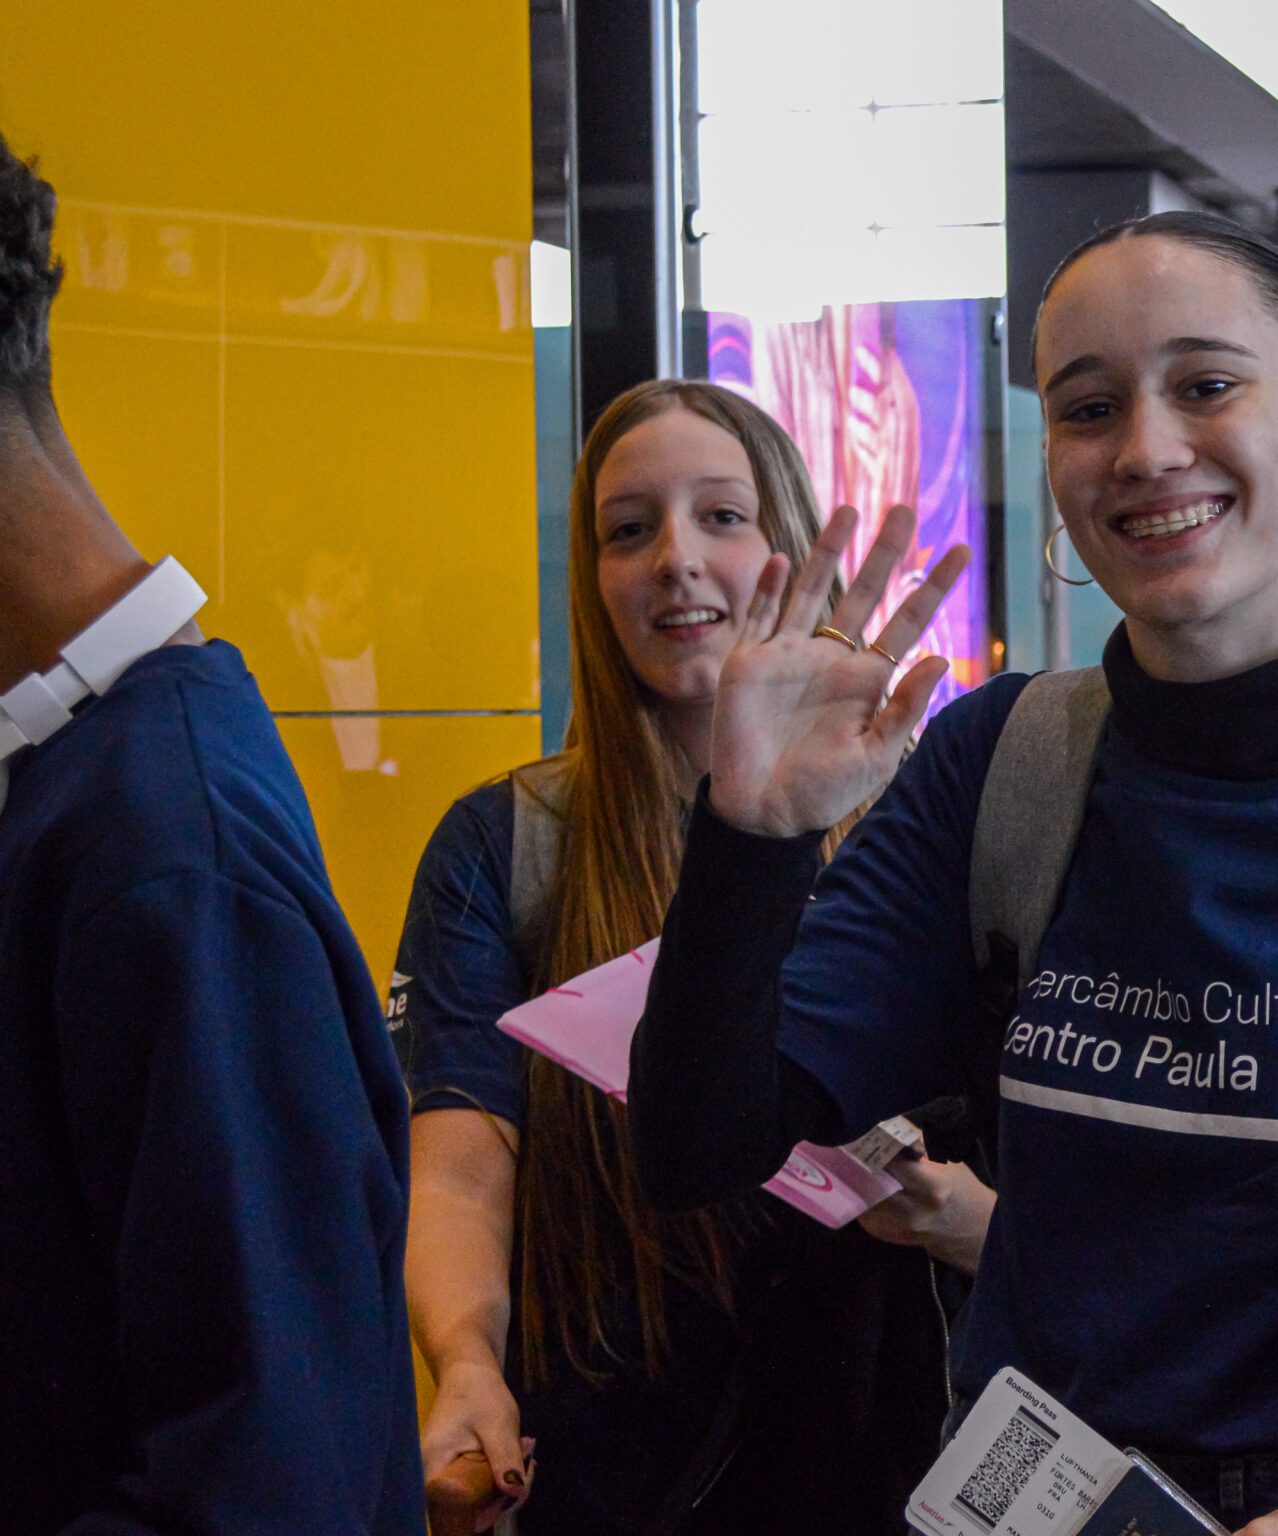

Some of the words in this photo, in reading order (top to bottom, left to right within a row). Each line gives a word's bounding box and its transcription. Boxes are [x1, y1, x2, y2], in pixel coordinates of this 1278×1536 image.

[1134, 1035, 1258, 1091] Paula
[1005, 1376, 1040, 1408] Boarding
[1037, 1401, 1058, 1421] Pass
[1060, 1453, 1098, 1486] LUFTHANSA
